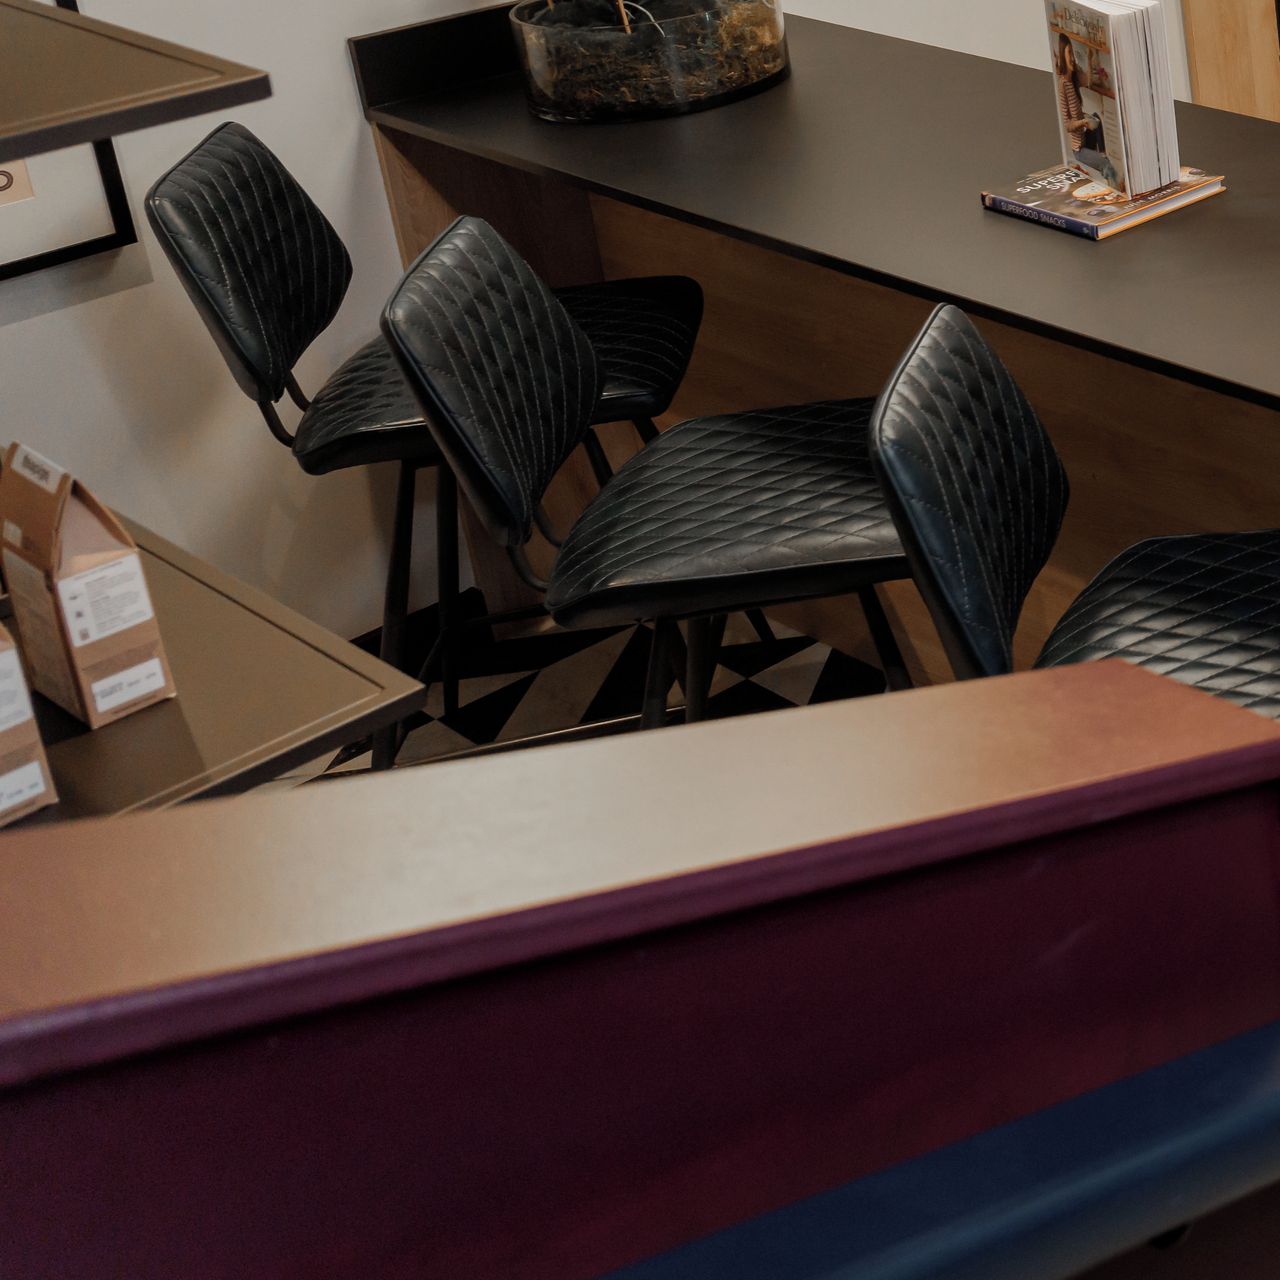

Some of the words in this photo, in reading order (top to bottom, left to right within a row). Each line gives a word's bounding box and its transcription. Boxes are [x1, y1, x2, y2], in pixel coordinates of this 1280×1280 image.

[1016, 170, 1078, 194] SUPERF
[1045, 175, 1087, 191] SNA
[1001, 201, 1039, 220] SUPERFOOD
[1040, 213, 1067, 228] SNACKS
